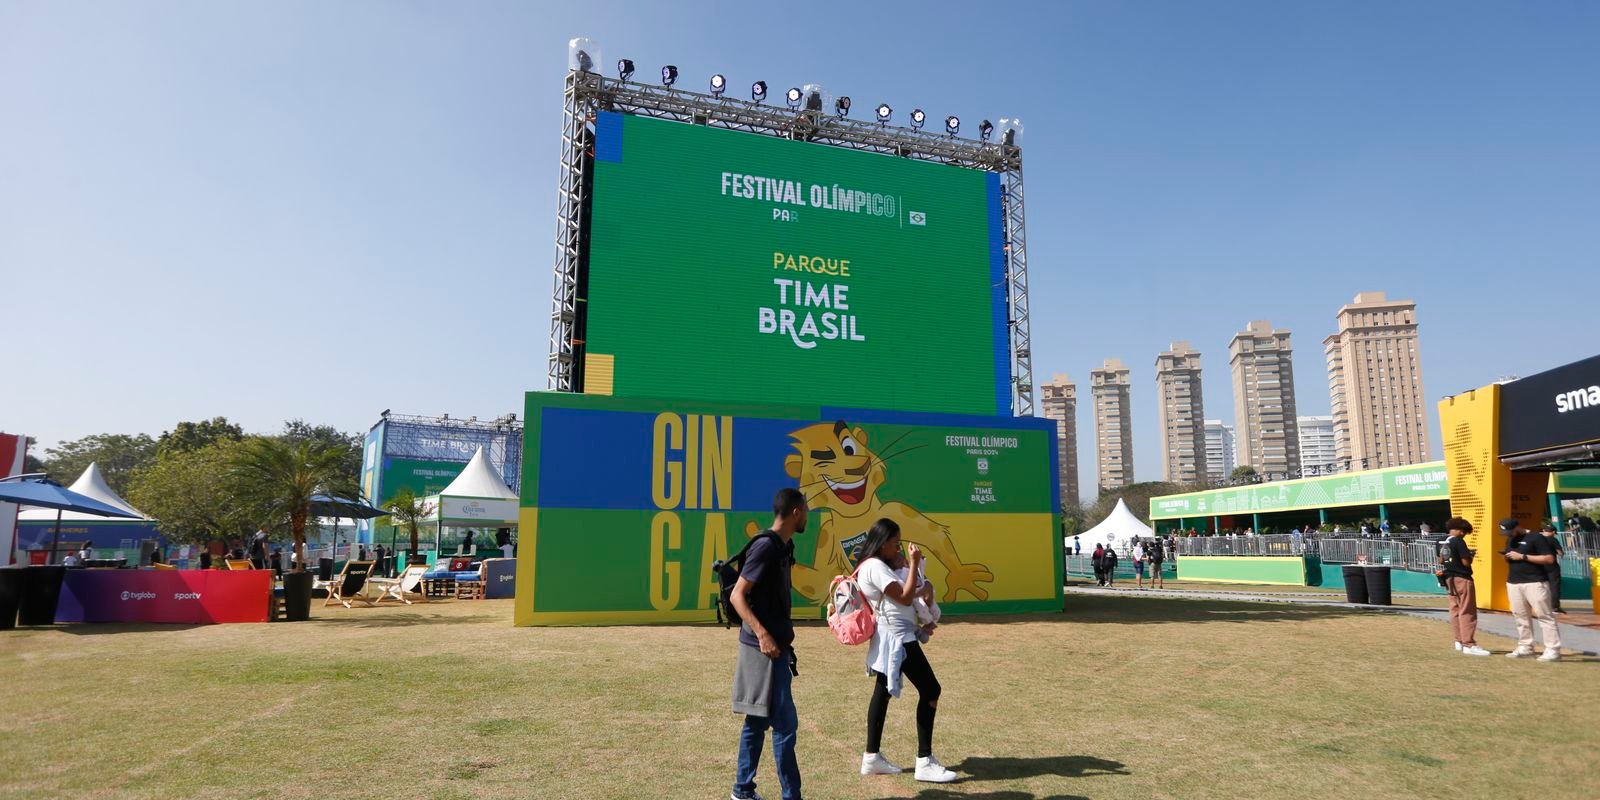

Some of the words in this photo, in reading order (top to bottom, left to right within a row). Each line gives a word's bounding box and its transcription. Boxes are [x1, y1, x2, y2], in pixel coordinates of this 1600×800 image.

[721, 172, 806, 206] FESTIVAL
[810, 183, 896, 218] OLÍMPICO
[773, 252, 851, 277] PARQUE
[773, 278, 849, 310] TIME
[759, 307, 866, 350] BRASIL
[421, 439, 446, 449] TIME
[945, 435, 980, 447] FESTIVAL
[981, 435, 1018, 448] OLÍMPICO
[651, 411, 733, 510] GIN
[1395, 473, 1424, 486] FESTIVAL
[974, 487, 993, 495] TIME
[971, 494, 996, 504] BRASIL
[174, 592, 201, 600] sportv
